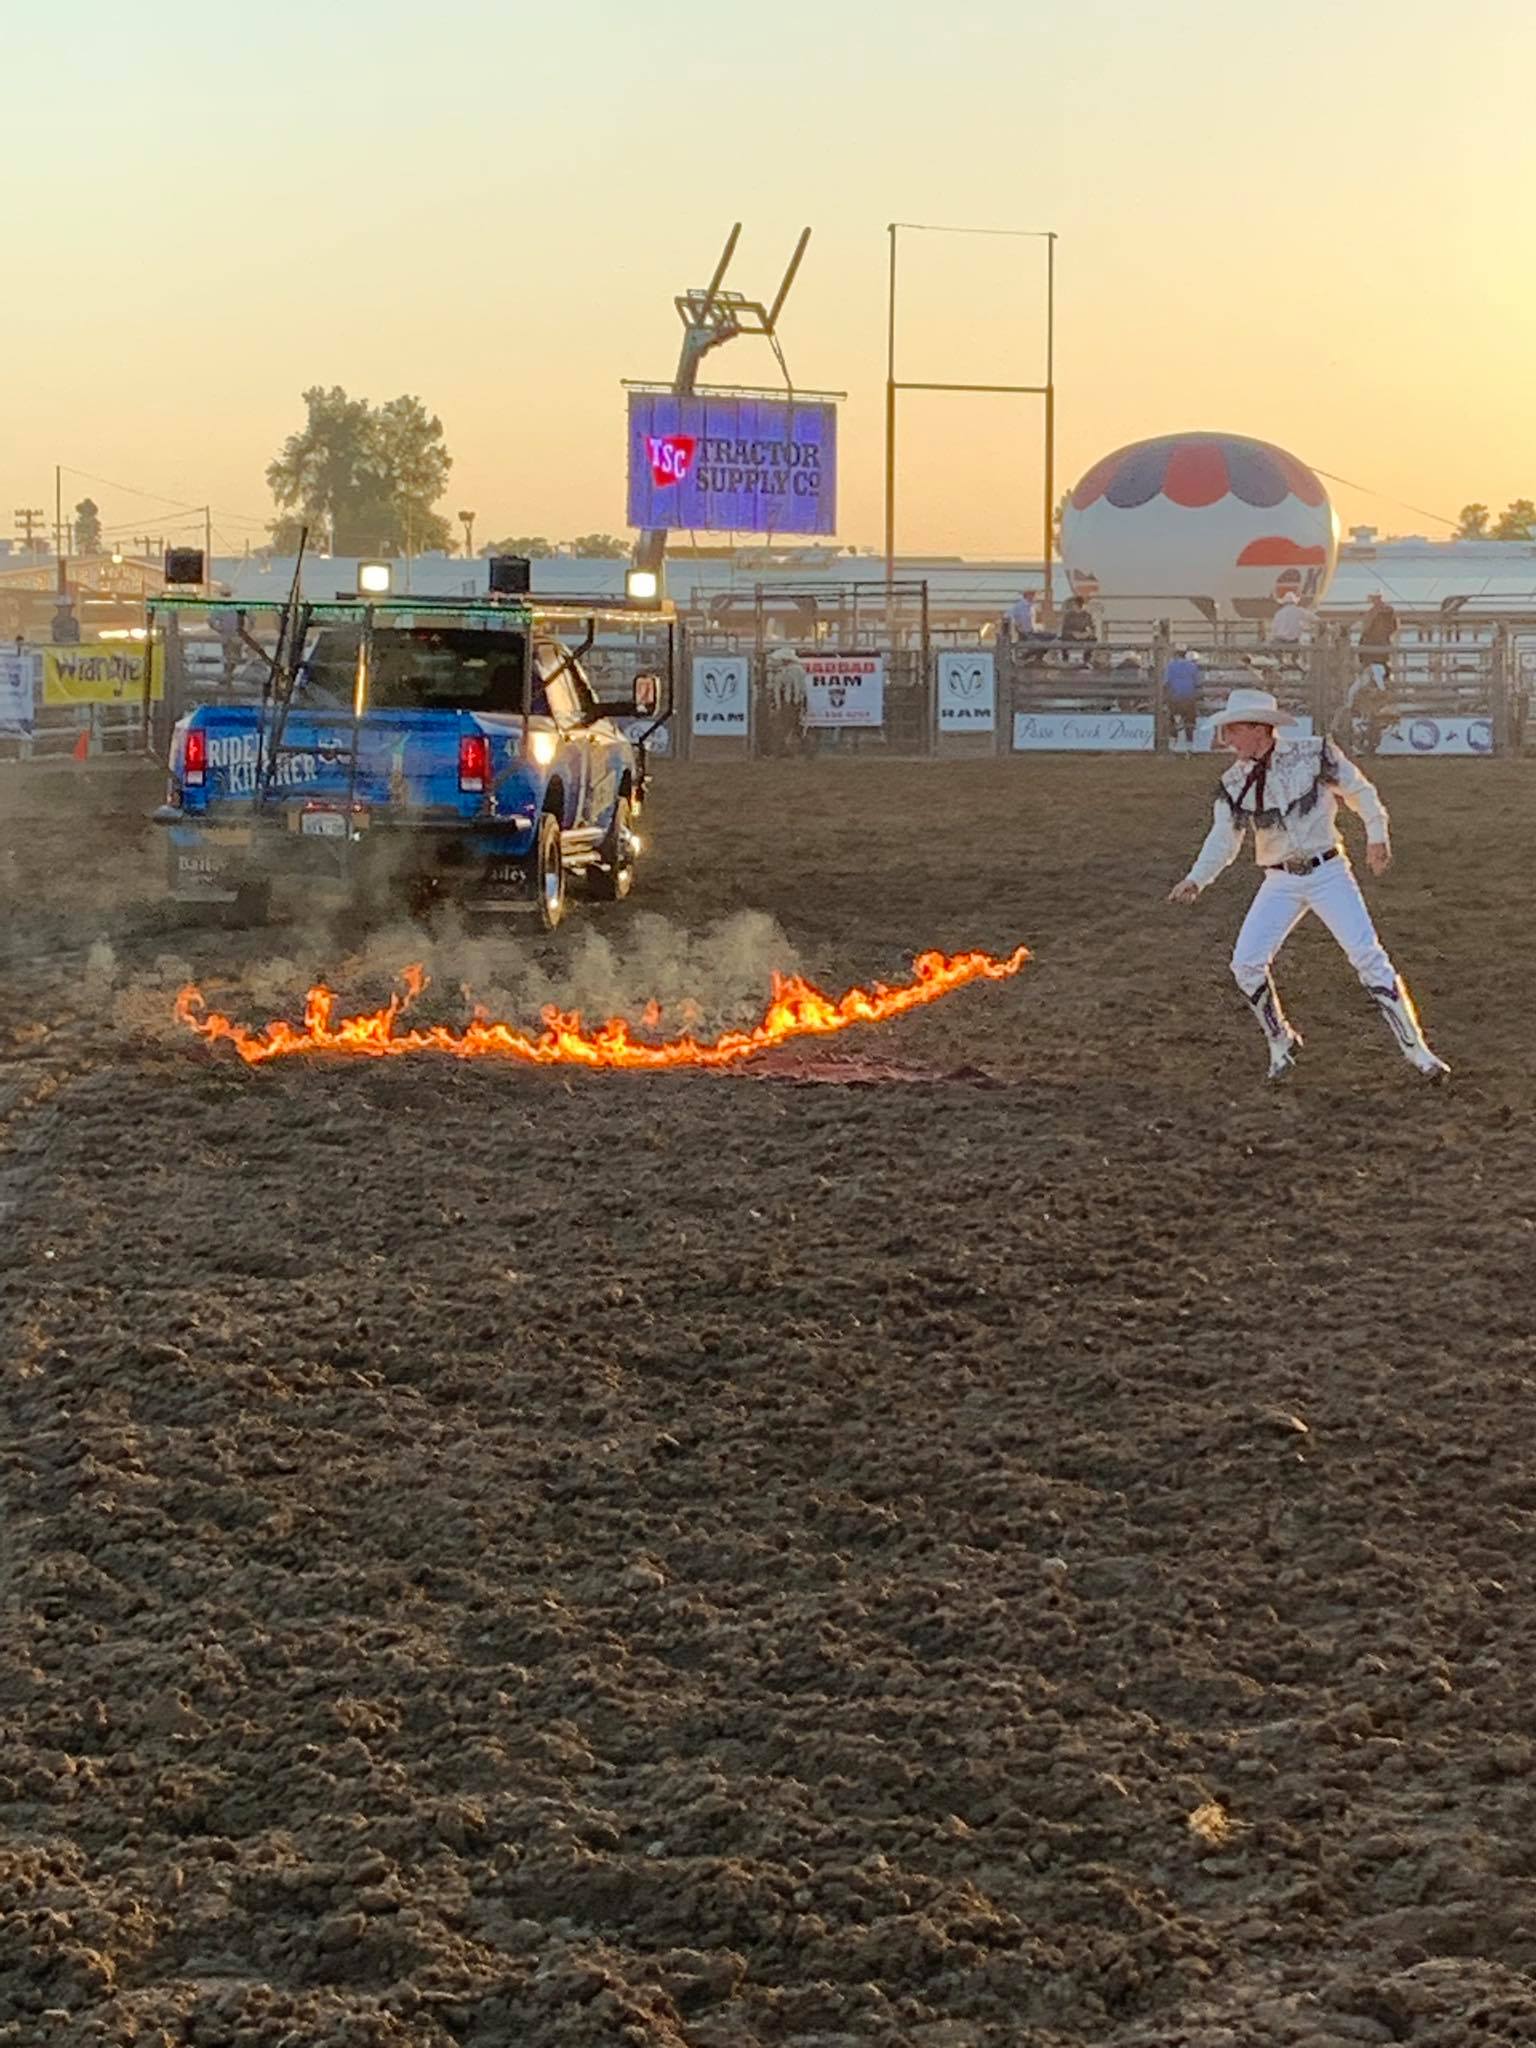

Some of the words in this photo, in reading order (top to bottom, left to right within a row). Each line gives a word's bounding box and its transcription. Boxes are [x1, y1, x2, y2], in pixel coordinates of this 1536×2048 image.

[649, 438, 686, 478] TSC
[697, 438, 821, 469] TRACTOR
[696, 467, 790, 495] SUPPLY
[813, 676, 862, 687] RAM
[696, 713, 744, 722] RAM
[942, 709, 991, 718] RAM
